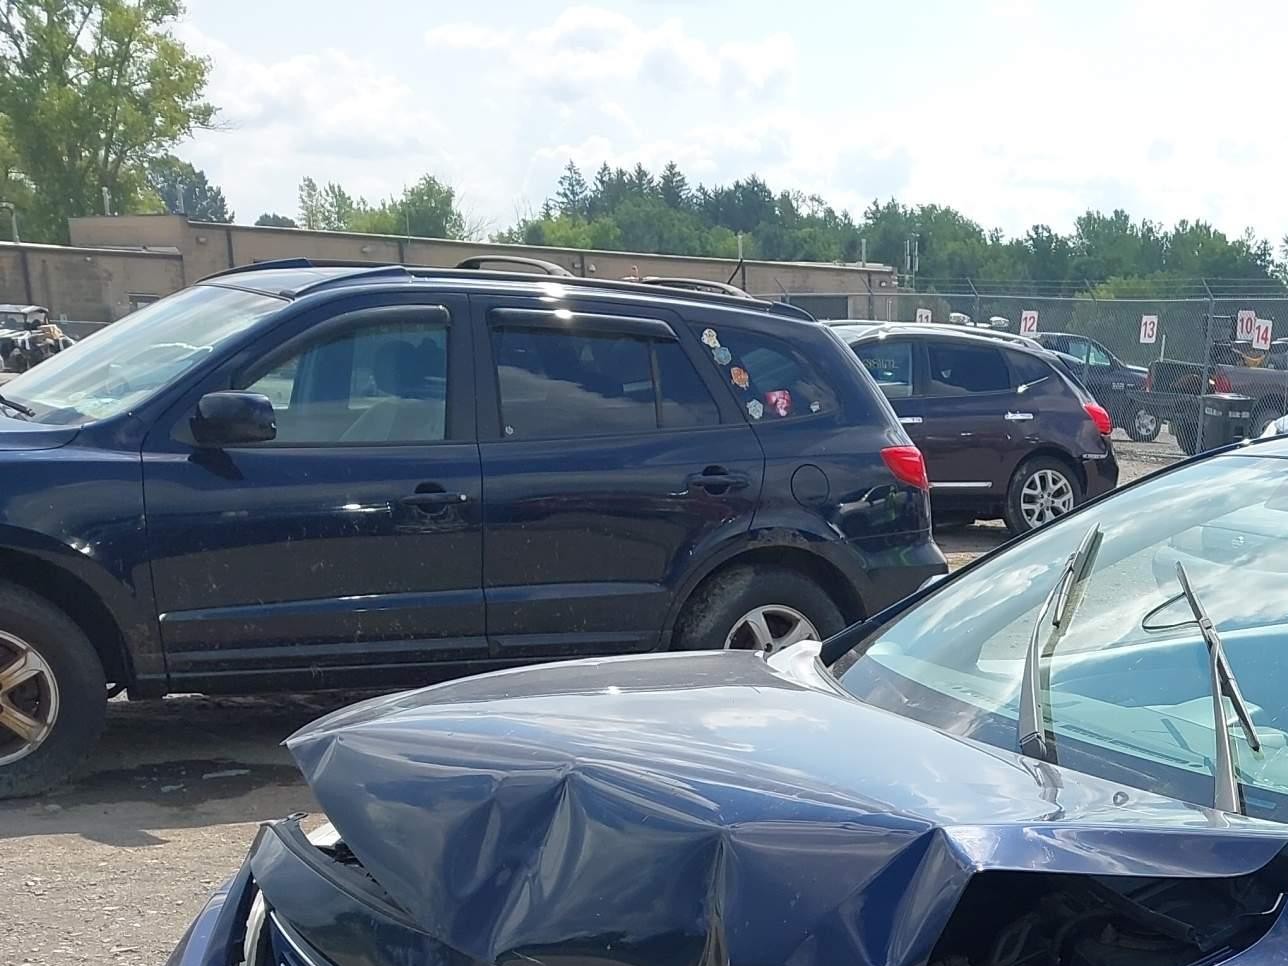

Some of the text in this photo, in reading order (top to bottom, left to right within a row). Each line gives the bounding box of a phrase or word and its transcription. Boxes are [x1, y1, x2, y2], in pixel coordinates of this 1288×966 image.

[1022, 316, 1036, 332] 12
[1142, 321, 1156, 339] 13
[1239, 317, 1253, 334] 10
[1255, 325, 1269, 345] 14
